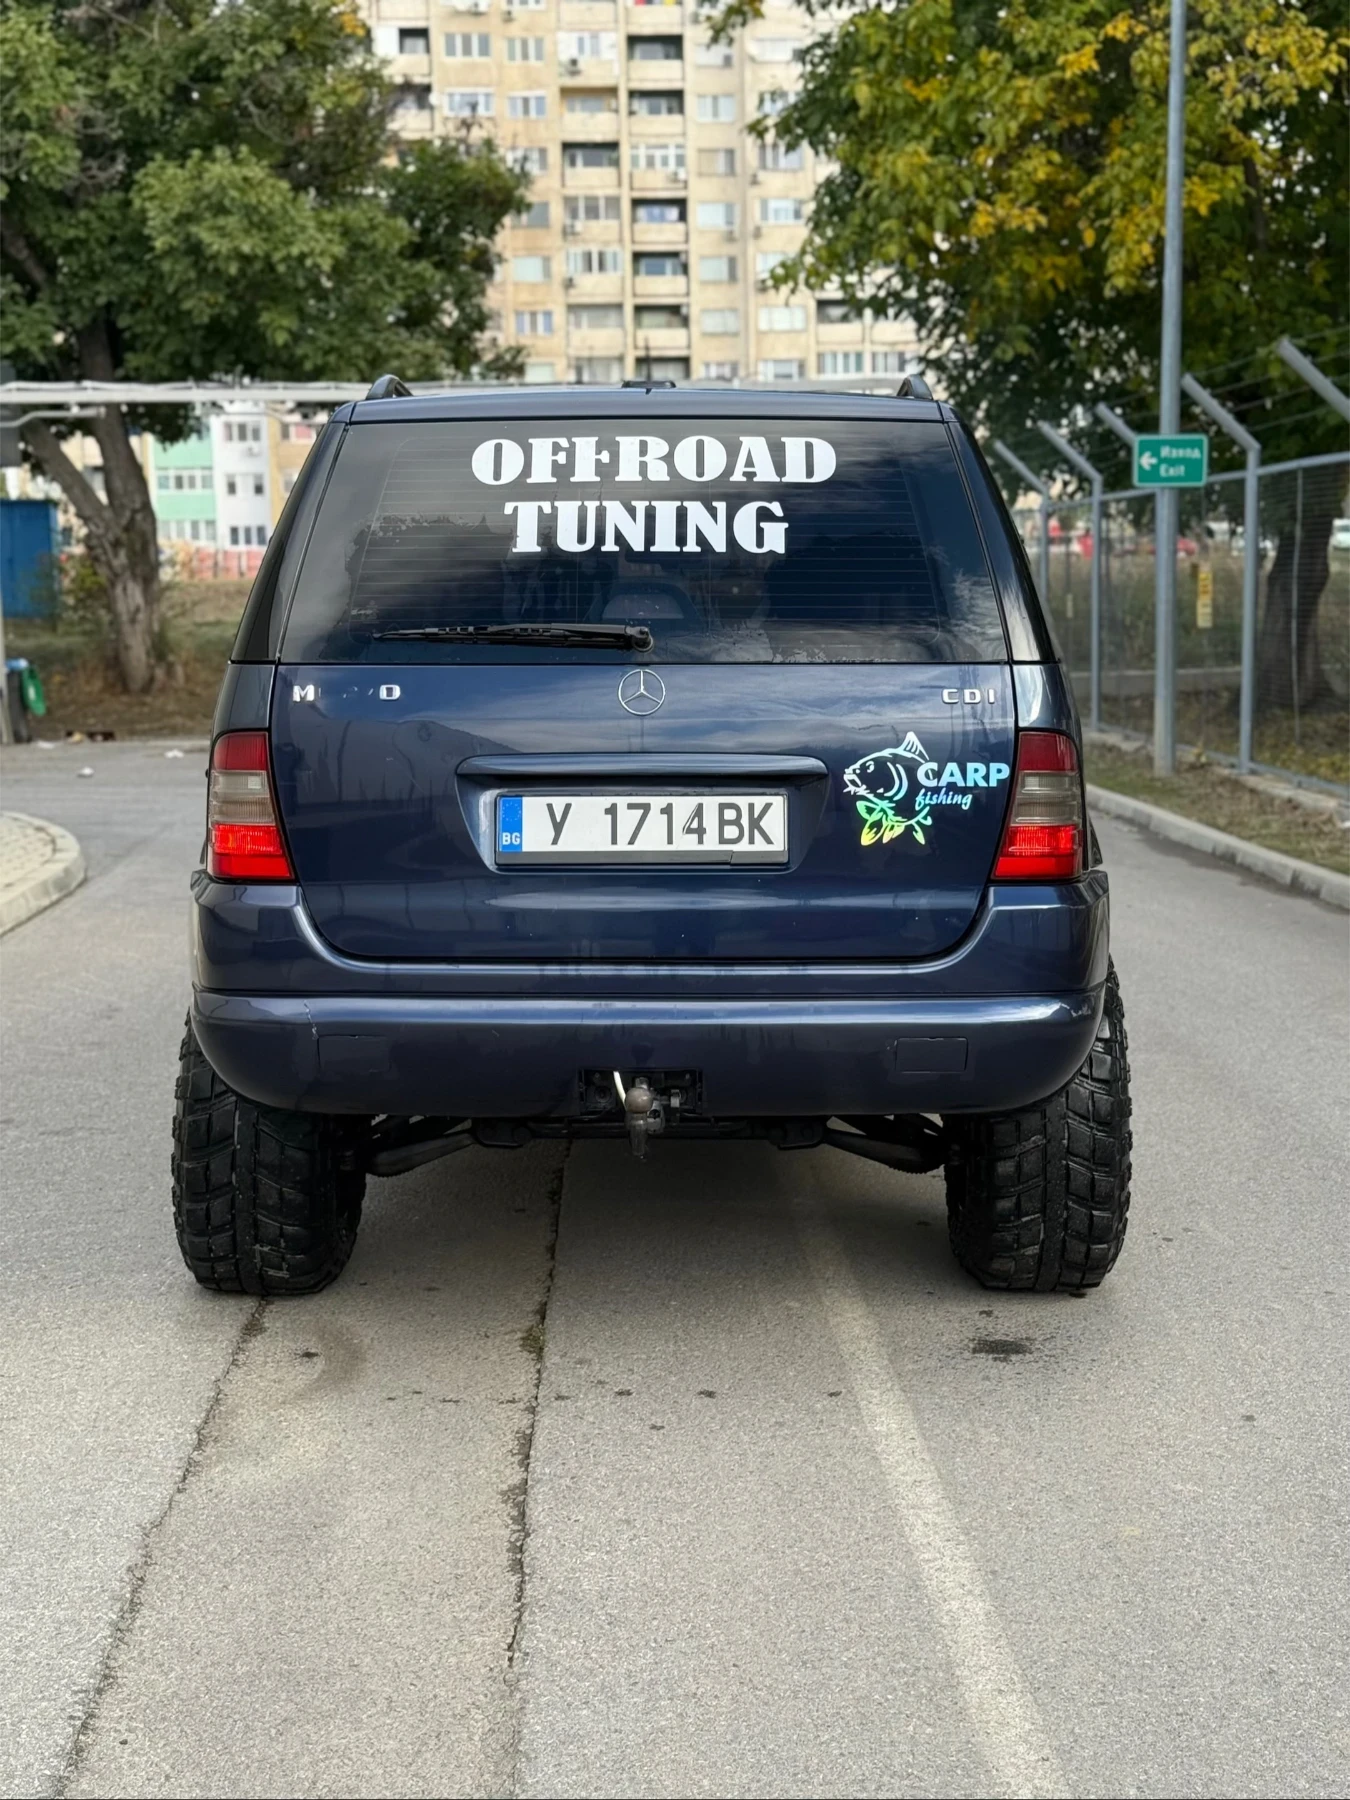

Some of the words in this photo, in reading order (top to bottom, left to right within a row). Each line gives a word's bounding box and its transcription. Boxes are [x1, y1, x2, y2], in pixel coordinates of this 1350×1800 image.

[503, 500, 789, 554] TUNING
[941, 688, 996, 704] CDI
[916, 762, 1010, 787] CARP
[915, 788, 973, 810] fishing
[501, 832, 521, 845] BG
